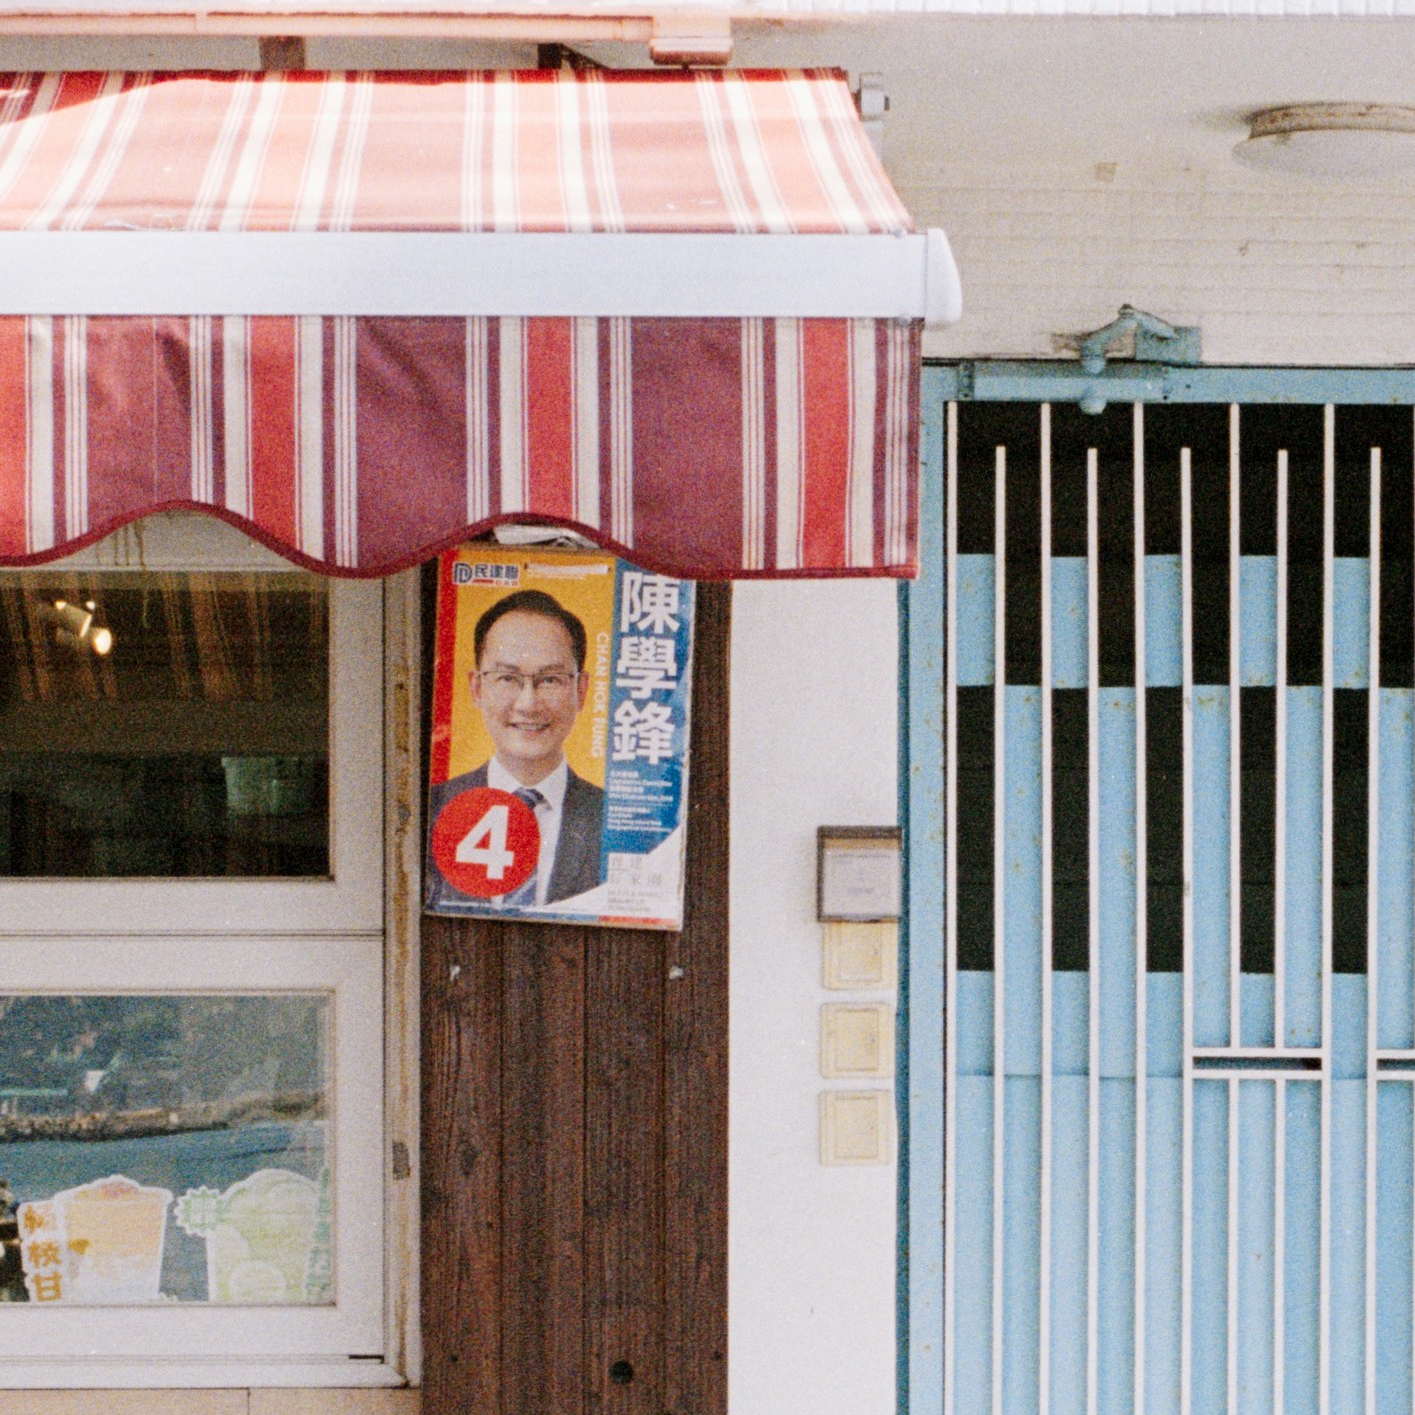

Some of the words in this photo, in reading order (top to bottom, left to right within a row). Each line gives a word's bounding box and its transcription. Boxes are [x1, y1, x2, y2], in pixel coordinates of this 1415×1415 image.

[595, 632, 610, 676] CHAN
[612, 571, 680, 766] 陳學鋒
[593, 680, 607, 714] HOK
[591, 716, 606, 758] FUNG
[455, 804, 514, 880] 4
